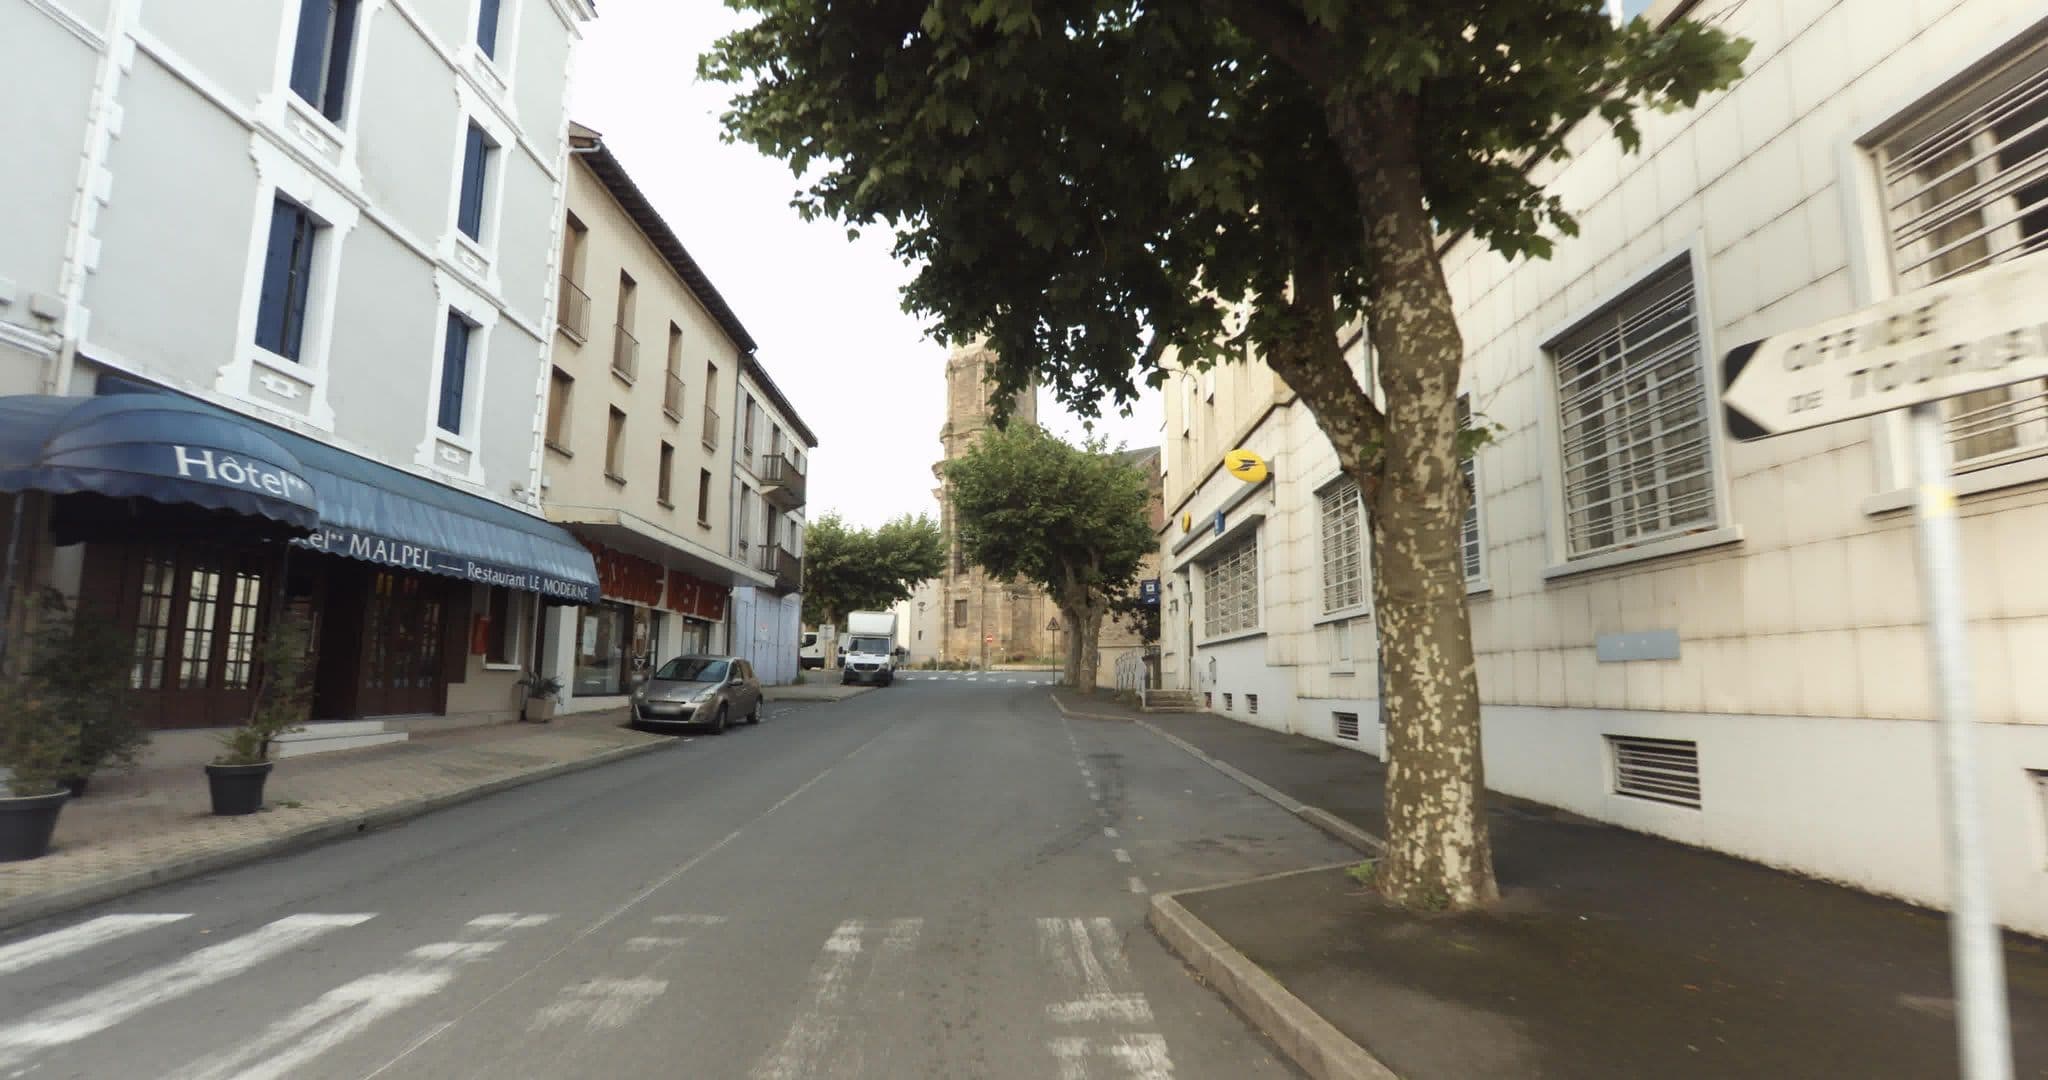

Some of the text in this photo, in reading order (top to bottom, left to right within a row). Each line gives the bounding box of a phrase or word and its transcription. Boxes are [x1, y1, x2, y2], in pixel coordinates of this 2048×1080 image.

[1782, 299, 1936, 372] OFFICE
[1787, 321, 2048, 414] DE TOURIS
[349, 533, 433, 569] MALPEL
[467, 561, 526, 588] Restaurant
[529, 575, 540, 591] LE
[543, 578, 589, 600] MODERNE
